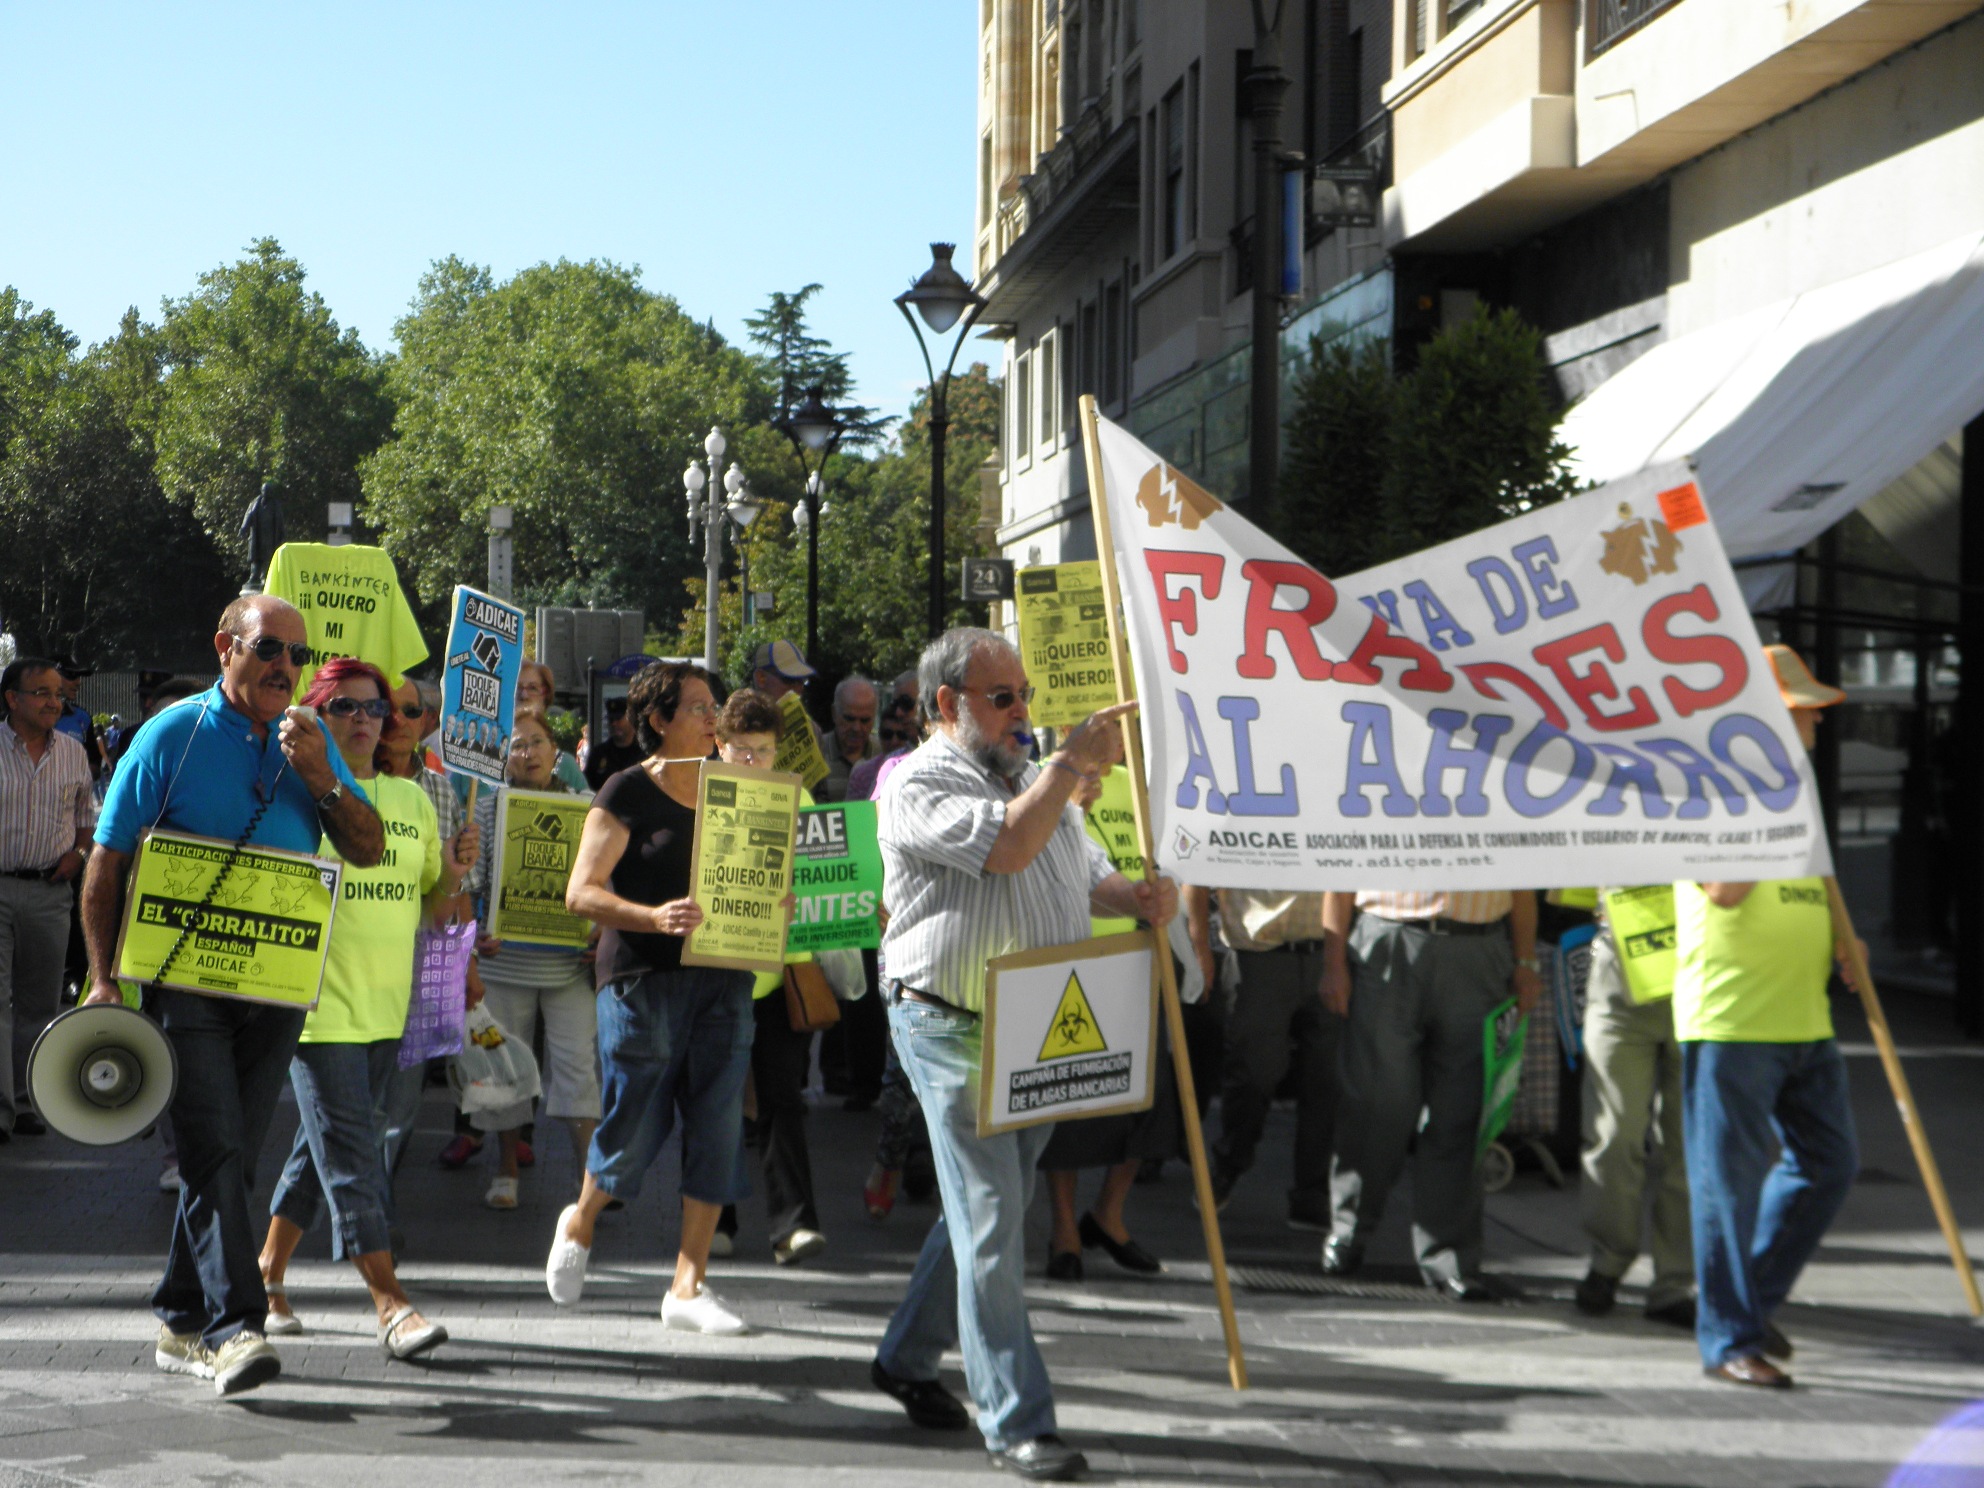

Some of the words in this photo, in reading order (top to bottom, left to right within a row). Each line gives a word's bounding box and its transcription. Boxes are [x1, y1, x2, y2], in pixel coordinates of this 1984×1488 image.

[973, 569, 994, 583] 24
[1466, 534, 1580, 636] DE
[475, 601, 518, 636] ADICAE
[324, 621, 343, 640] MI
[465, 672, 493, 692] TOQUE
[465, 687, 497, 713] BANCA
[1175, 688, 1300, 816] AL
[1337, 699, 1801, 820] AHORRO
[1209, 830, 1299, 850] ADICAE
[1305, 831, 1368, 850] ASOCIACIÓN
[1369, 833, 1400, 850] PARA
[1402, 833, 1417, 849] LA
[1418, 833, 1464, 849] DEFENSA
[1466, 833, 1482, 849] DE
[527, 852, 564, 869] BANCA
[769, 871, 784, 890] MI
[792, 862, 858, 887] FRAUDE
[141, 902, 167, 923] EL
[711, 896, 772, 920] DINERO!!!
[196, 938, 254, 956] ESPAÑOL
[195, 954, 248, 976] ADICAE
[1012, 1067, 1056, 1090] CAMPAÑA
[1056, 1067, 1070, 1080] DE
[1071, 1053, 1130, 1078] FUMIGACIÓN
[1011, 1094, 1027, 1111] DE
[1028, 1085, 1068, 1108] PLAGAS
[1069, 1075, 1129, 1101] BANCARIAS
